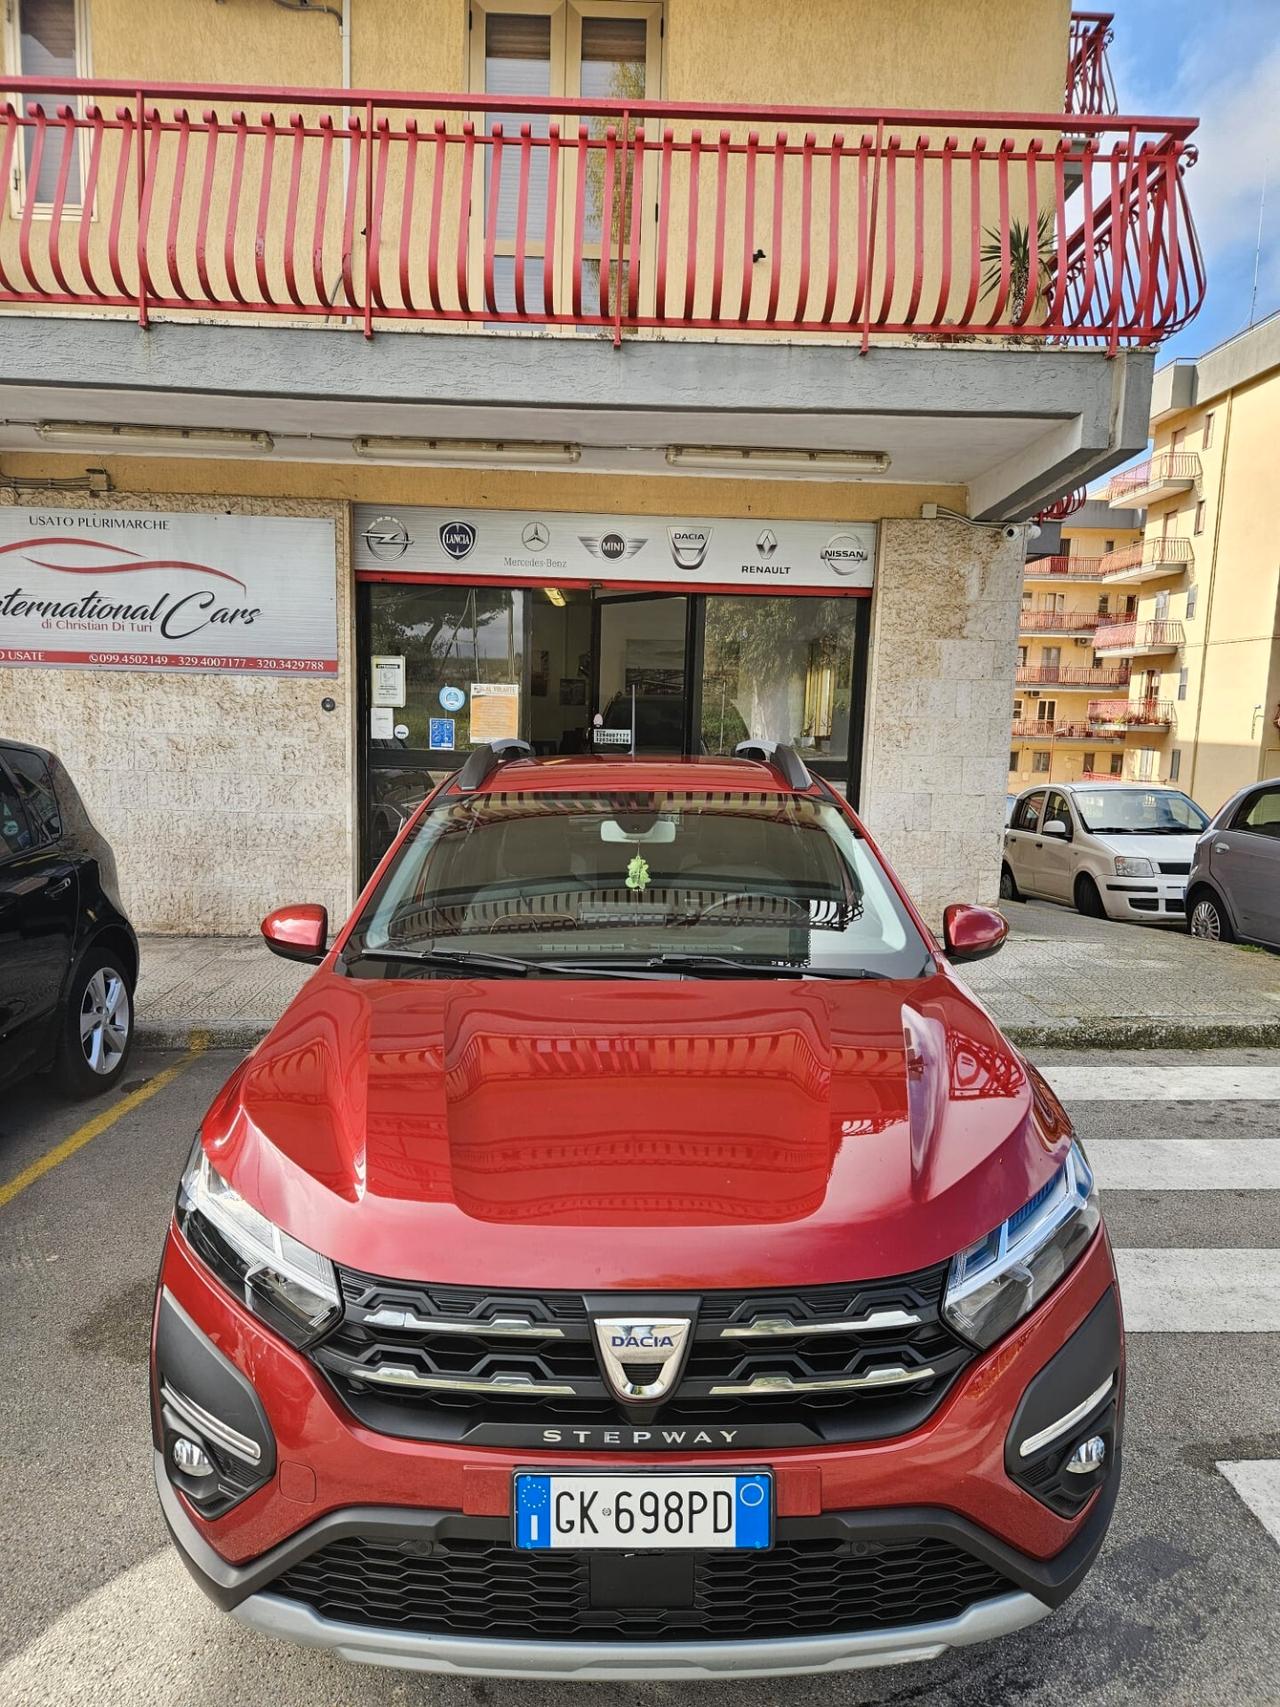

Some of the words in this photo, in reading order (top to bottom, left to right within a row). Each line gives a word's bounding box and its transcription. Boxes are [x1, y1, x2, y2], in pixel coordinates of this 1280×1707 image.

[29, 515, 74, 528] USATO
[78, 517, 170, 530] PLURIMARCHE
[446, 534, 470, 546] LANCIA
[673, 532, 705, 541] DACIA
[602, 541, 624, 552] MINI
[824, 549, 864, 559] NISSAN
[503, 557, 568, 568] Mercedes-Benz
[741, 565, 791, 575] RENAULT
[160, 591, 263, 639] Cars
[41, 618, 52, 630] di
[56, 620, 108, 632] Christian
[112, 622, 125, 632] Di
[129, 622, 152, 633] Turi
[8, 651, 45, 661] USATE
[100, 653, 168, 664] 099.4502149
[178, 656, 247, 667] 329.4007177
[256, 659, 325, 671] 320.3429788
[611, 1335, 674, 1348] DACIA
[542, 1430, 738, 1444] STEPWAY
[554, 1490, 599, 1534] GK
[614, 1490, 733, 1534] 698PD
